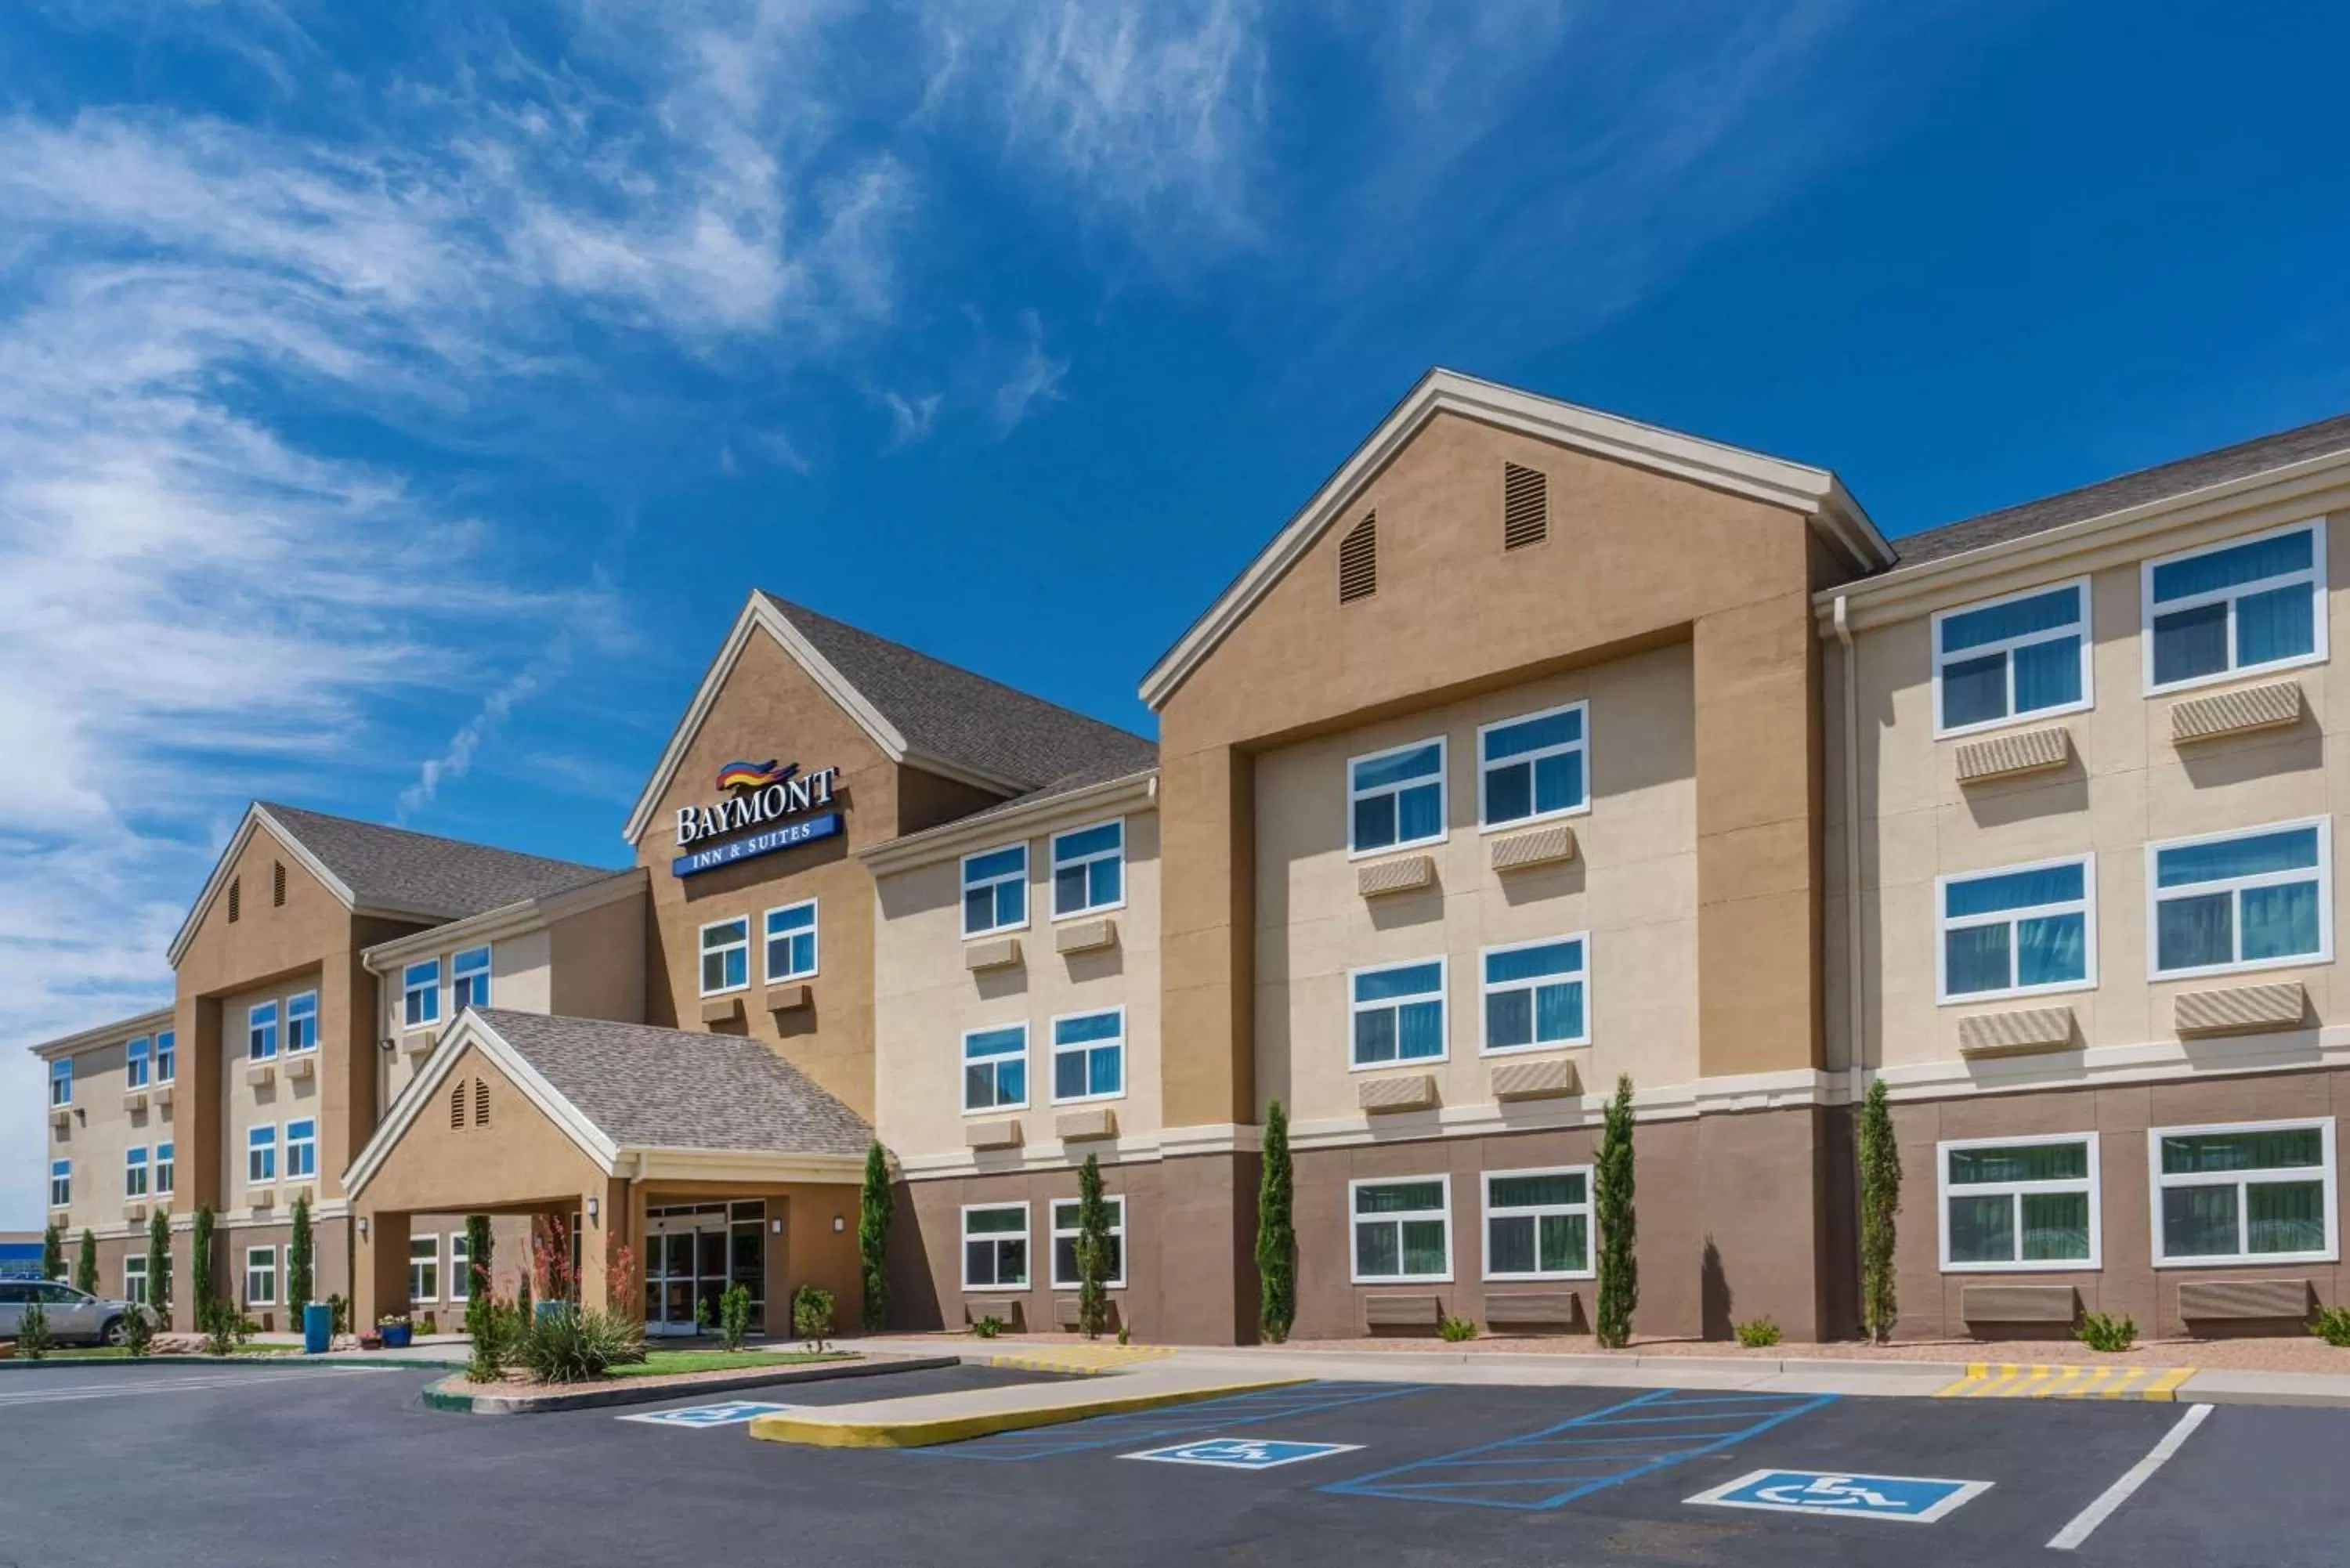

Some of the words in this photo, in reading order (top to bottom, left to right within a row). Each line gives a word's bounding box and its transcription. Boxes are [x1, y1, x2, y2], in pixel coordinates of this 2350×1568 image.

[676, 767, 838, 846] BAYMONT
[692, 850, 721, 869] INN
[729, 844, 741, 858] &
[748, 823, 812, 853] SUITES
